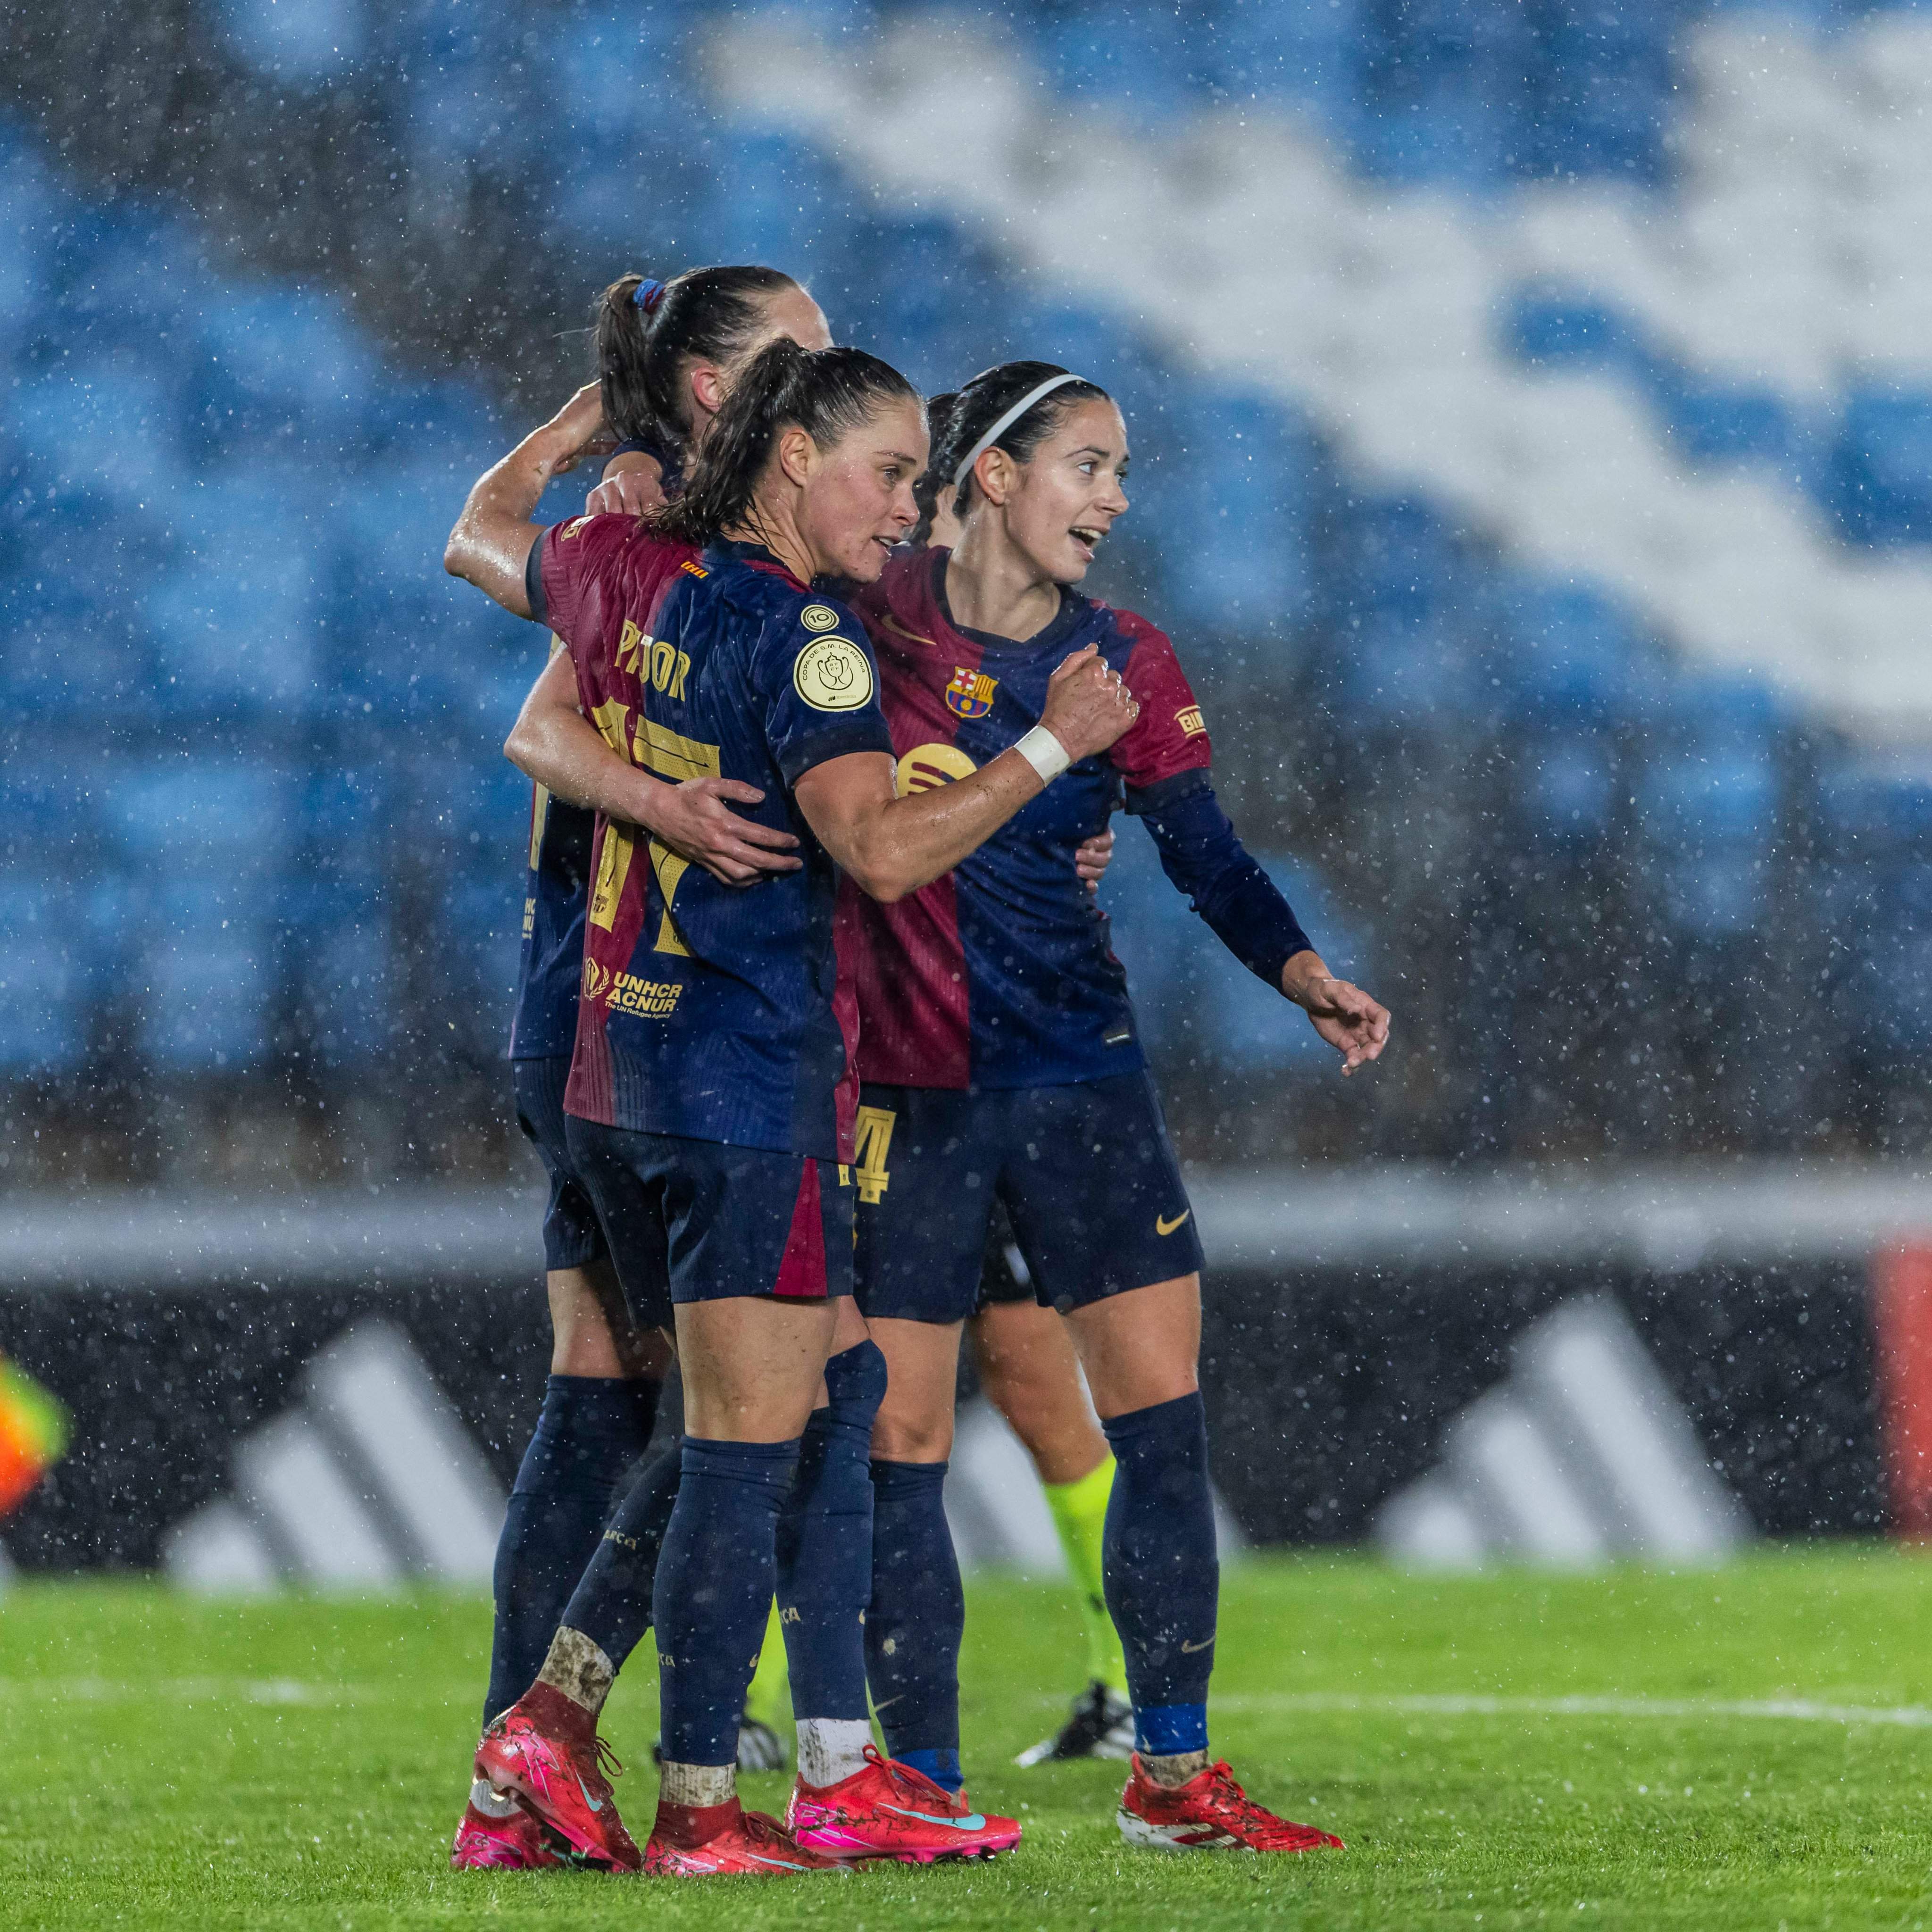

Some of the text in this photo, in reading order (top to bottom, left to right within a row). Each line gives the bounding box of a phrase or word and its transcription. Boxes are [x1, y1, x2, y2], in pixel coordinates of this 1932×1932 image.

[810, 614, 829, 623] 10
[803, 660, 811, 681] COPA
[809, 650, 820, 659] DE
[849, 650, 866, 673] REINA
[614, 971, 683, 998] UNHCR
[604, 1000, 616, 1009] The
[617, 1005, 627, 1013] UN
[627, 1008, 652, 1018] Refugee
[606, 988, 677, 1012] ACNUR
